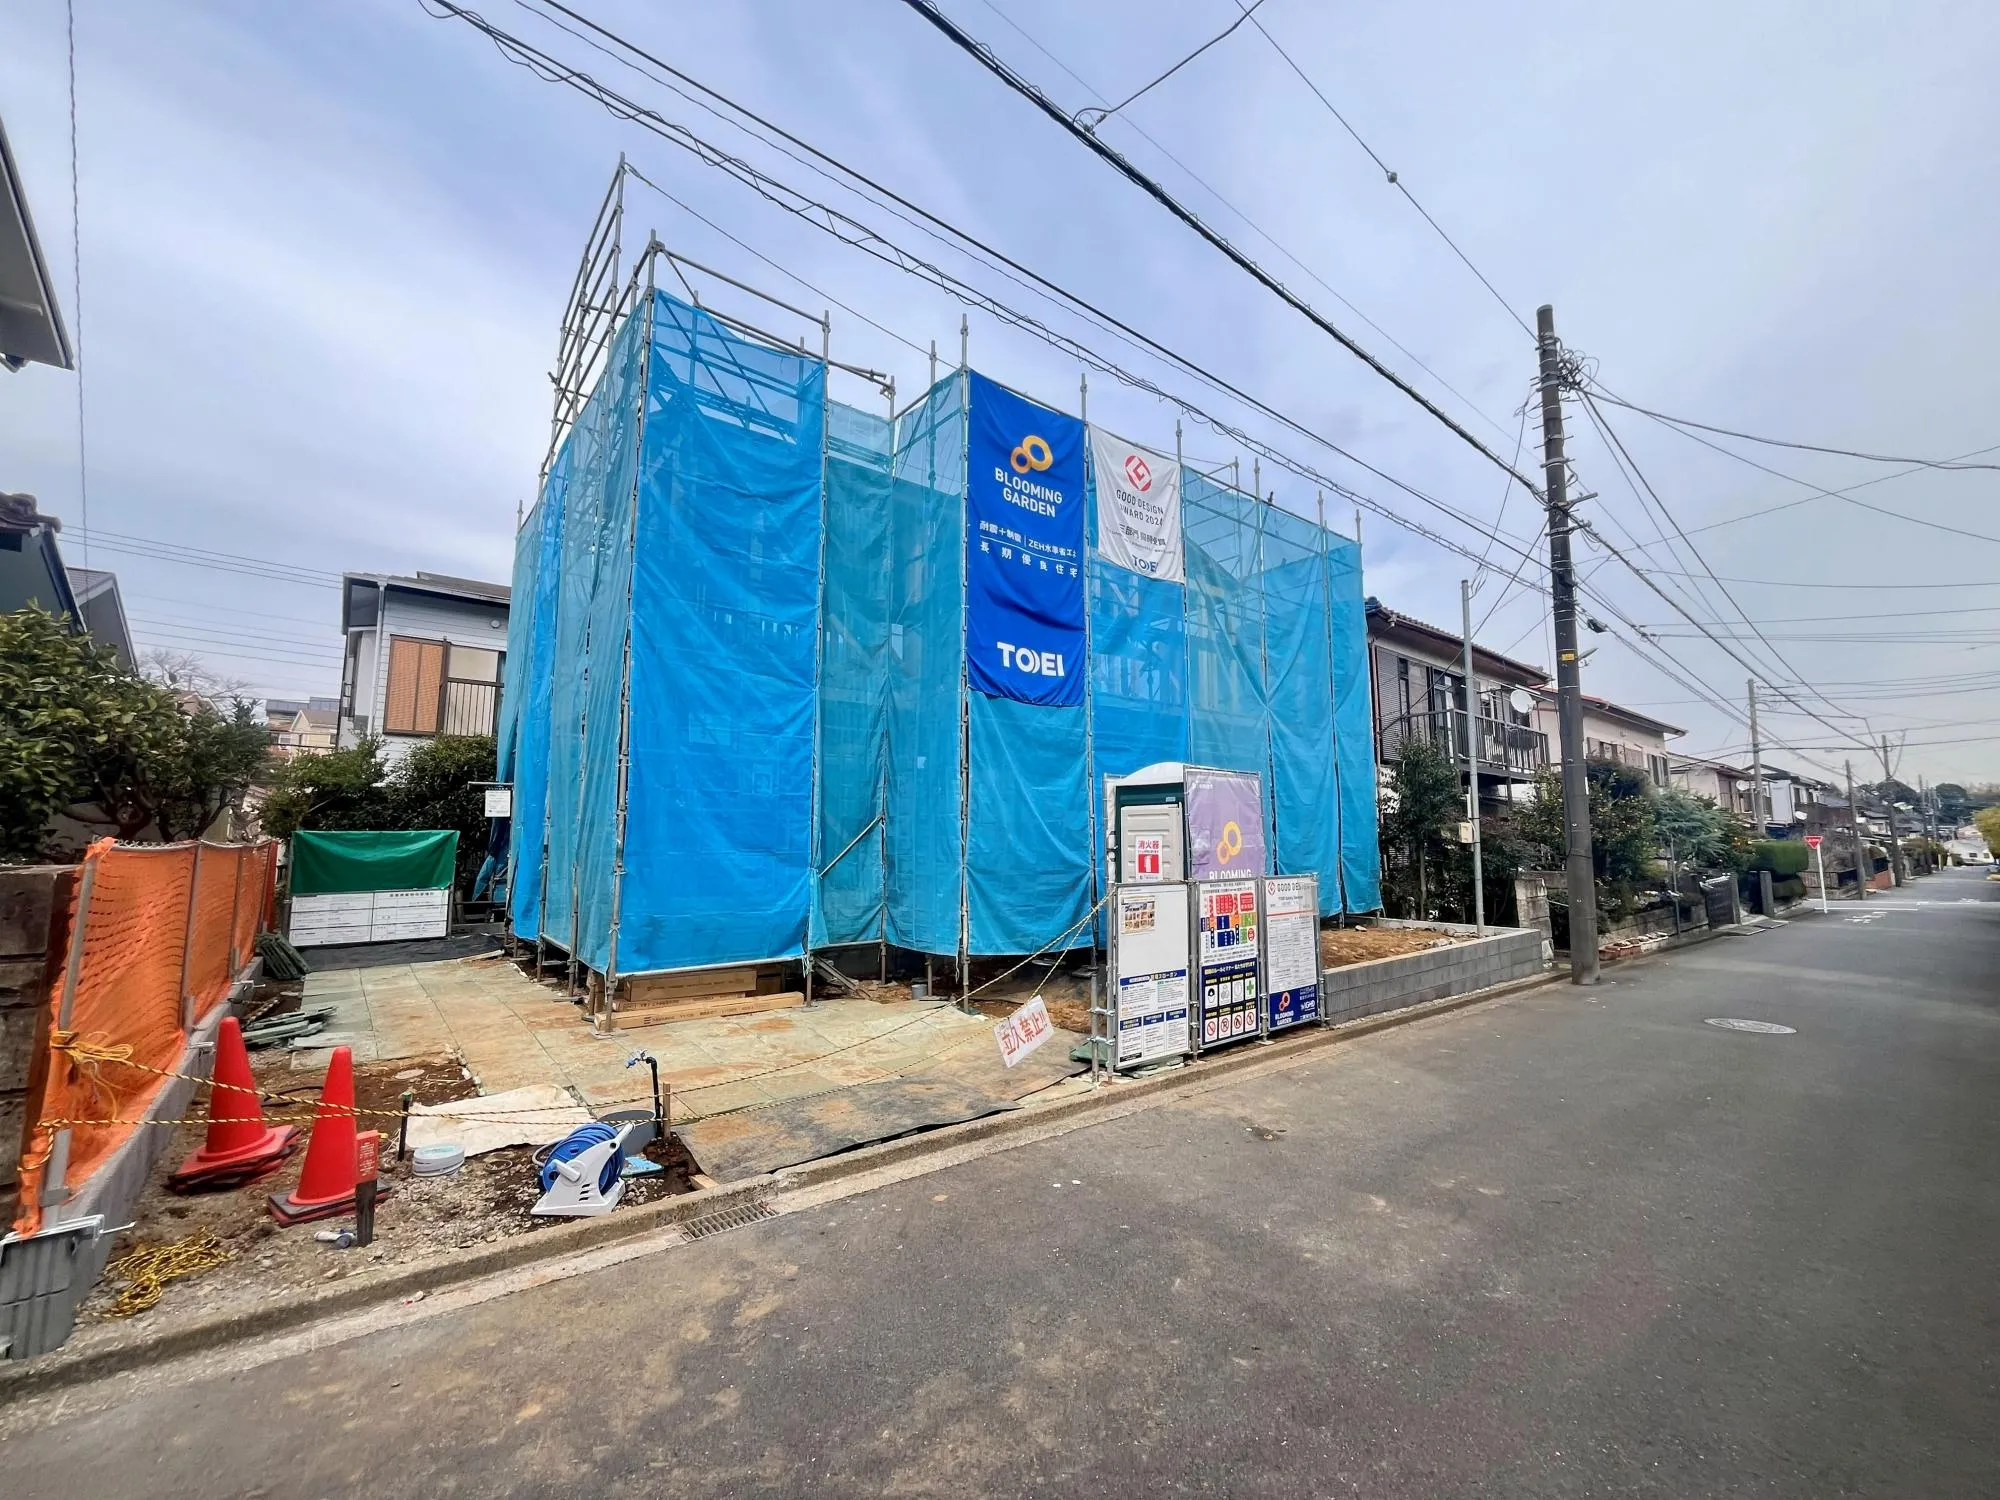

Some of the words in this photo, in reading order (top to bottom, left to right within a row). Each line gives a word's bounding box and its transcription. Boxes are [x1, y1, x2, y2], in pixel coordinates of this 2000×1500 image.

[995, 467, 1063, 504] BLOOMING
[1003, 487, 1056, 518] GARDEN
[1116, 489, 1137, 506] GOOD
[1137, 498, 1164, 515] DESIGN
[996, 641, 1065, 677] TOEI
[1138, 840, 1160, 850] 消火器
